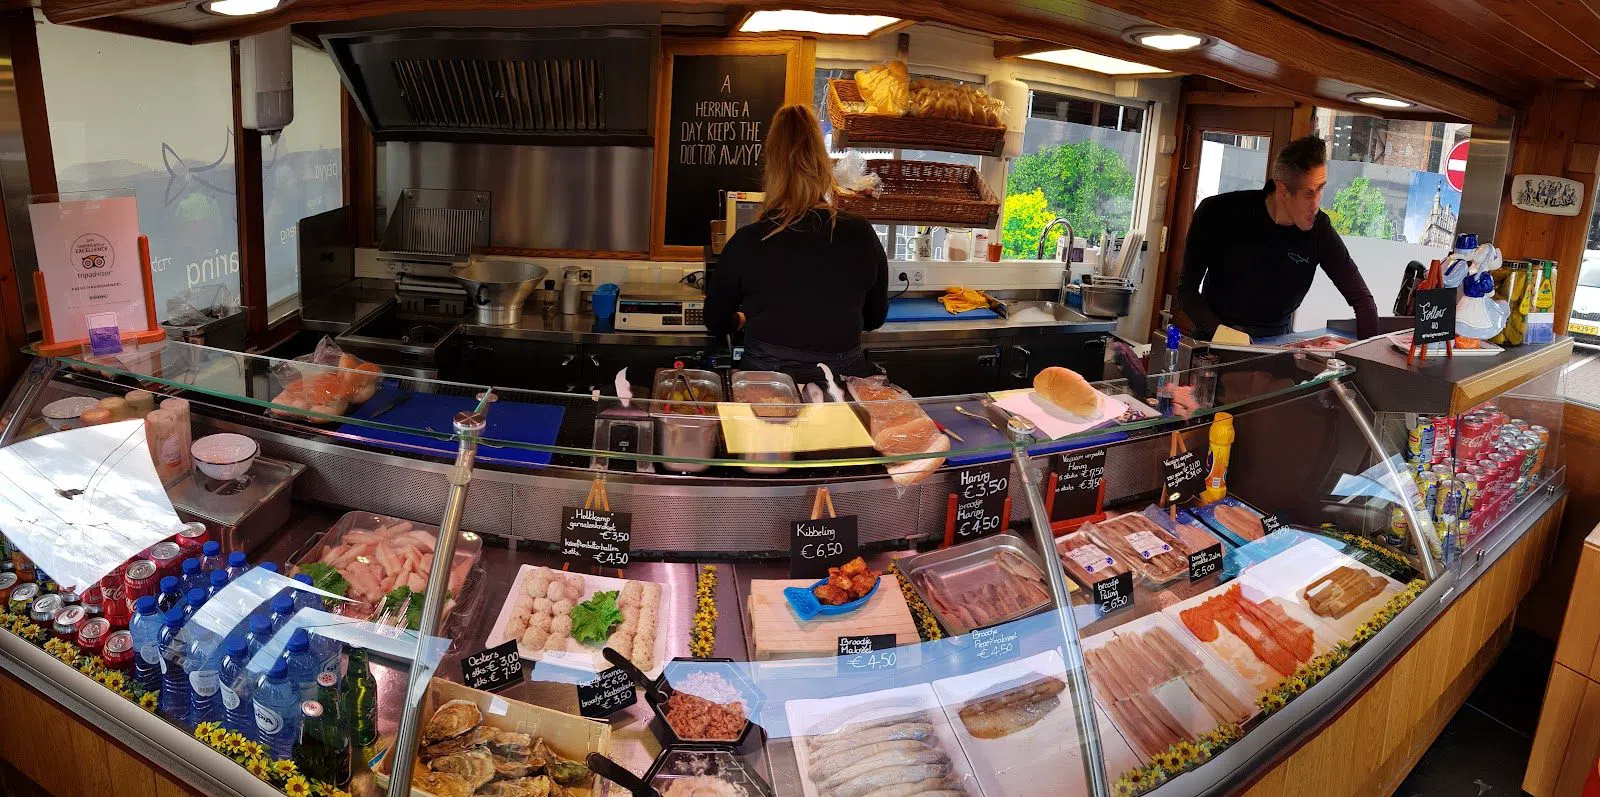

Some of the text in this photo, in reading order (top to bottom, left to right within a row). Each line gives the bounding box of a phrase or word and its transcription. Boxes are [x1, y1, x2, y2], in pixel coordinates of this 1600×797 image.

[720, 74, 731, 93] A
[695, 100, 750, 118] HERRING A
[707, 121, 737, 141] KEEPS
[739, 121, 762, 142] THE
[680, 143, 763, 166] DOCTOR AWAY!
[75, 246, 107, 254] EXCELLENCE
[77, 270, 112, 280] tripadvisor
[1419, 301, 1448, 322] Follow
[1067, 461, 1088, 471] Haring
[960, 470, 991, 486] Haring
[958, 499, 984, 511] broodje
[956, 508, 985, 521] Haring
[796, 523, 836, 541] Kibbeling
[1097, 577, 1120, 591] broodje
[1100, 589, 1119, 601] Paling
[972, 627, 999, 640] Broodje
[839, 636, 873, 649] Broodje
[468, 651, 500, 667] Oesters
